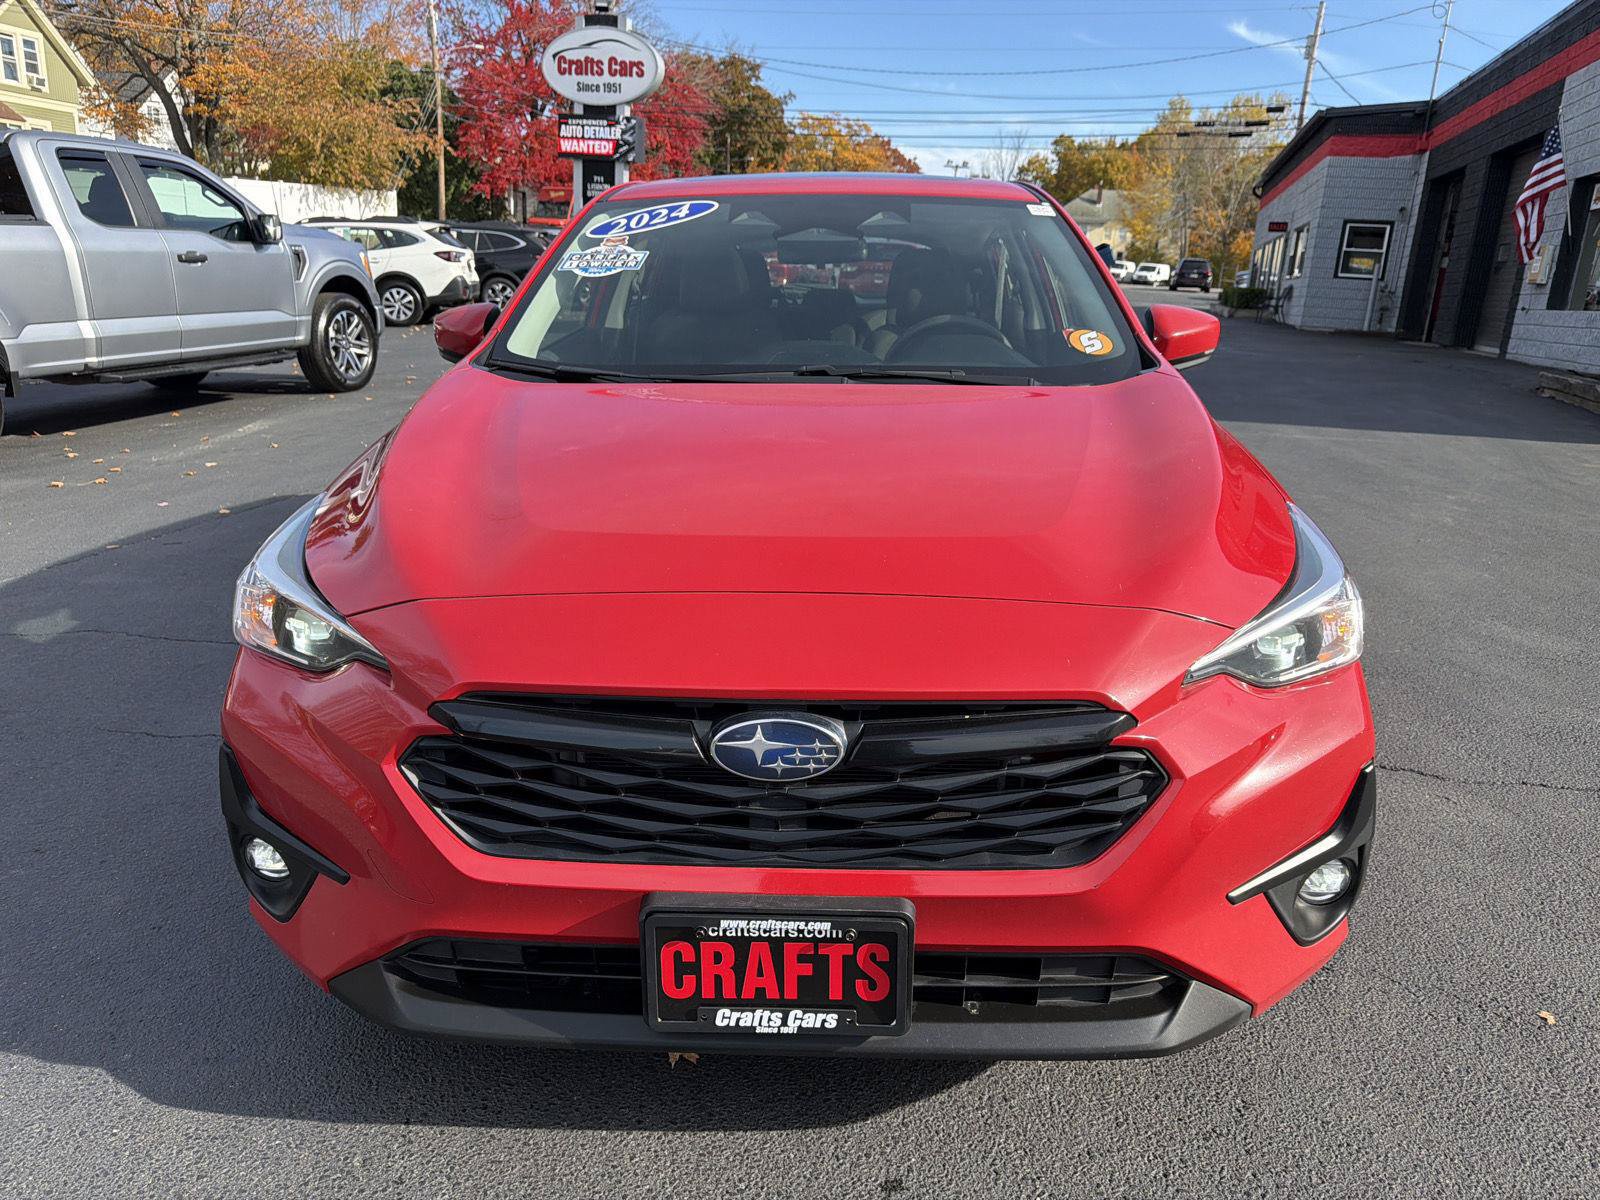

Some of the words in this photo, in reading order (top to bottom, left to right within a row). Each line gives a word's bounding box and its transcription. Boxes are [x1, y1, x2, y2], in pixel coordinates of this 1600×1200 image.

[557, 55, 604, 77] Crafts
[607, 57, 645, 78] Cars
[576, 82, 600, 93] Since
[602, 83, 622, 94] 1951
[560, 124, 583, 138] AUTO
[584, 125, 622, 140] DETAILER
[560, 138, 614, 155] WANTED!
[609, 201, 692, 235] 2024
[571, 253, 641, 261] CARFAX
[578, 260, 637, 268] OWNER
[720, 919, 831, 930] www.craftscars.com
[660, 940, 891, 1002] CRAFTS
[715, 1008, 783, 1028] Crafts
[786, 1009, 839, 1029] Cars
[755, 1026, 778, 1034] Since
[779, 1026, 798, 1034] 1951
